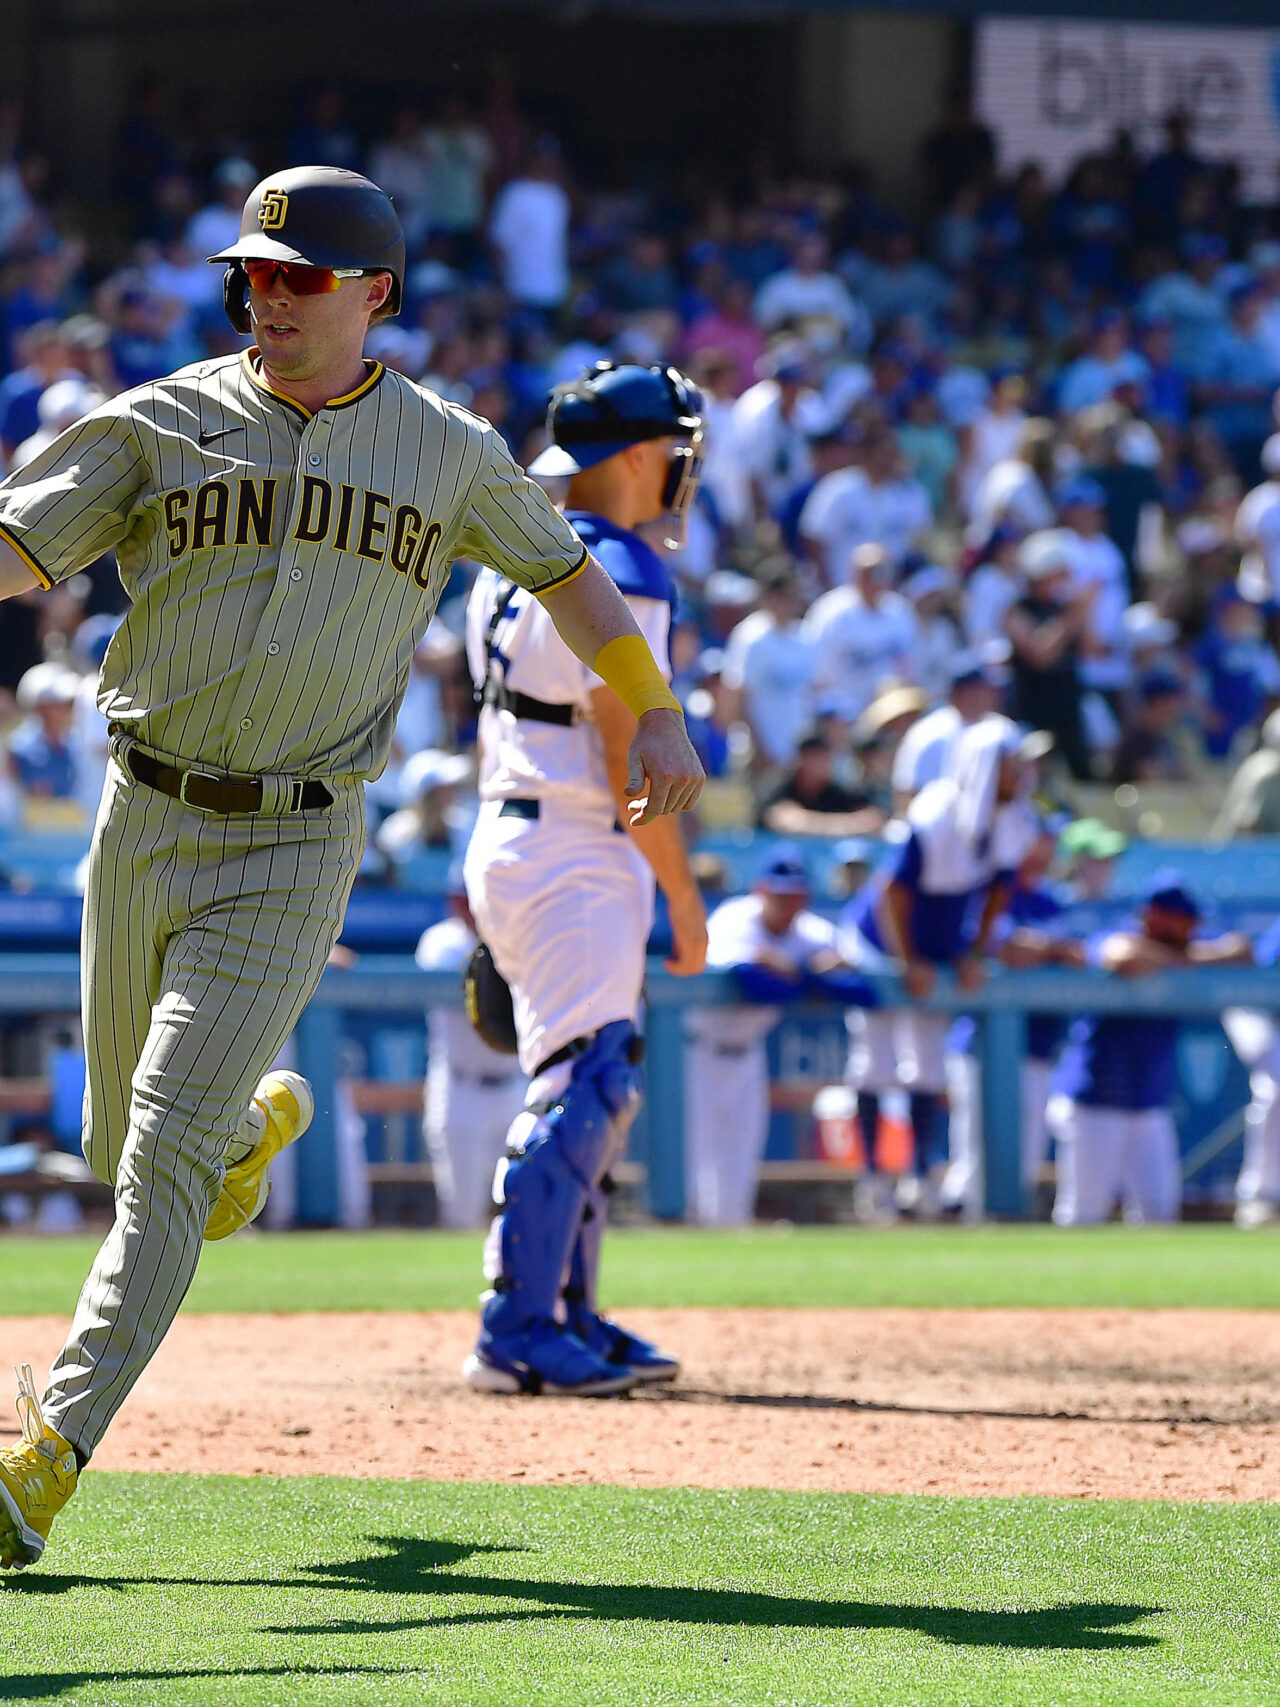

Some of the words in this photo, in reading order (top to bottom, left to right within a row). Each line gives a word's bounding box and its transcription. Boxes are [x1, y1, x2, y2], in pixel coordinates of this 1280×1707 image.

[1037, 24, 1244, 132] blue
[258, 188, 289, 230] SD
[163, 477, 280, 560] SAN
[292, 473, 442, 590] DIEGO
